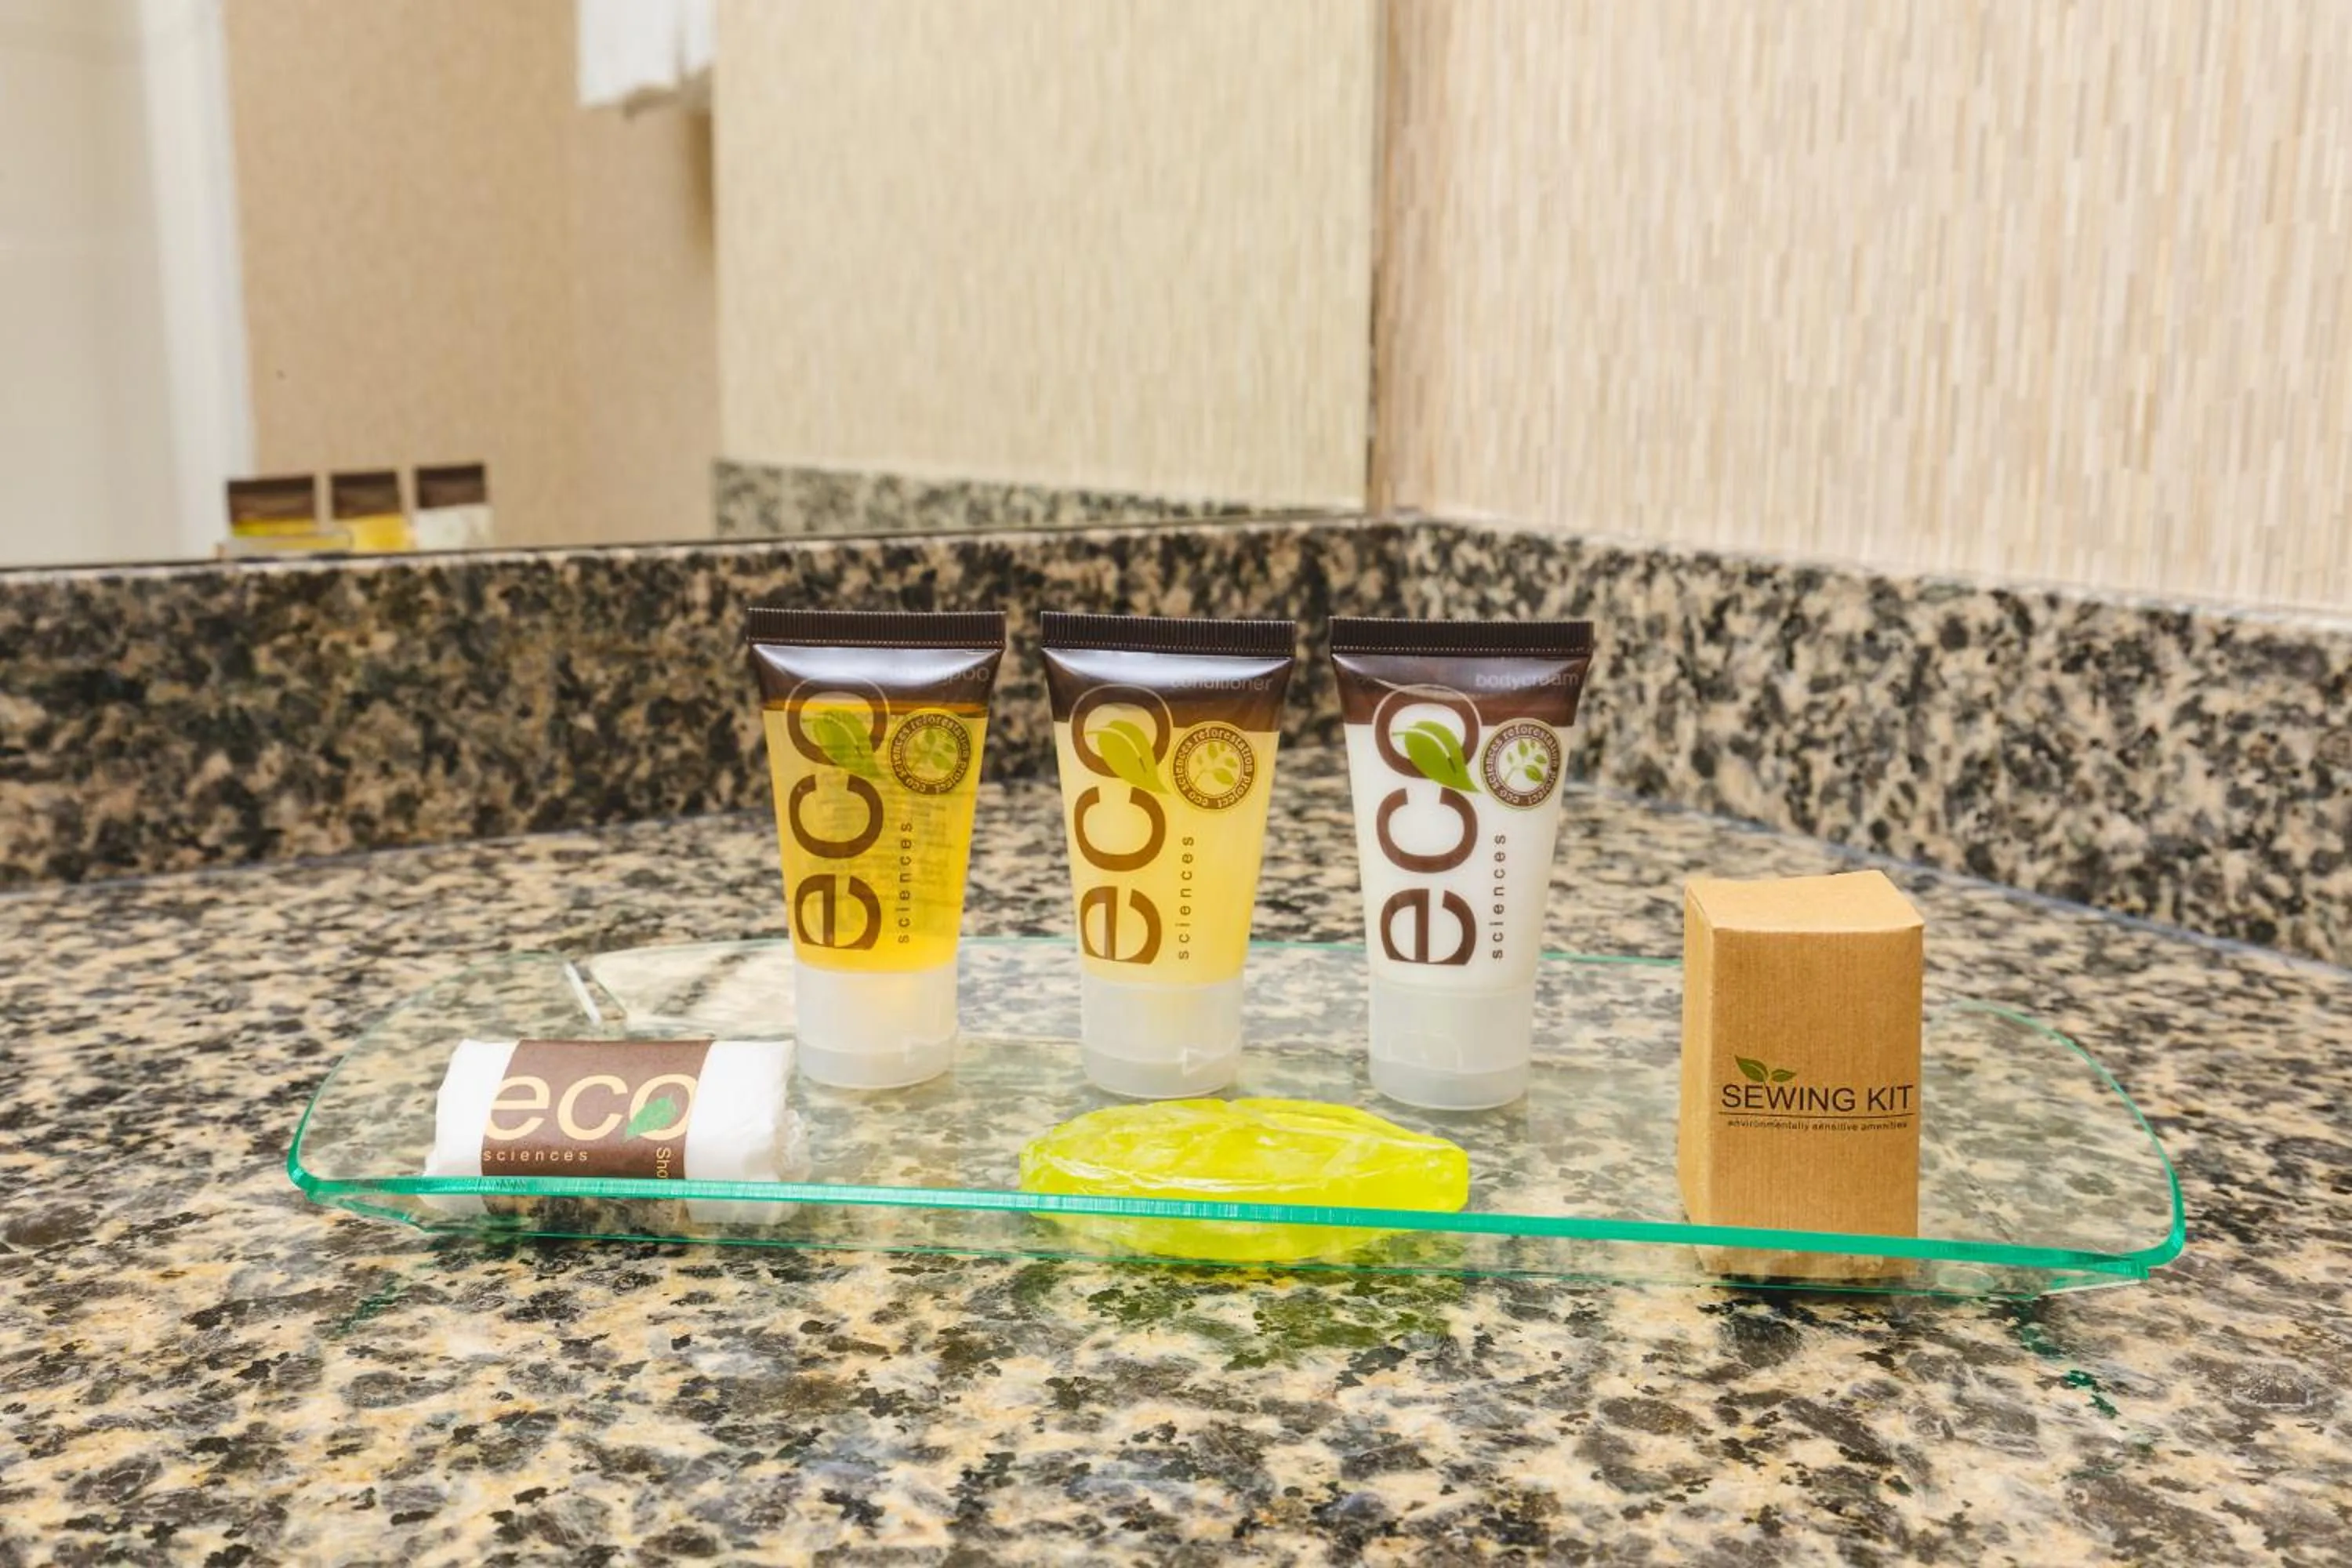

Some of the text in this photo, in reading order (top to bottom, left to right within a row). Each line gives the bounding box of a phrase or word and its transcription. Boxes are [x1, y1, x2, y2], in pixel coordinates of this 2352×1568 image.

[1171, 677, 1273, 691] conditioner
[1475, 672, 1579, 691] bodycream
[786, 675, 889, 950] eco
[1070, 684, 1172, 964] eco
[1373, 684, 1482, 965] eco
[895, 821, 913, 944] sciences
[1174, 835, 1195, 960] sciences
[1488, 833, 1507, 960] sciences
[485, 1073, 699, 1142] eco
[1721, 1083, 1914, 1112] SEWING KIT
[1727, 1119, 1907, 1131] environmentally sensitive amenities
[482, 1149, 589, 1162] sciences
